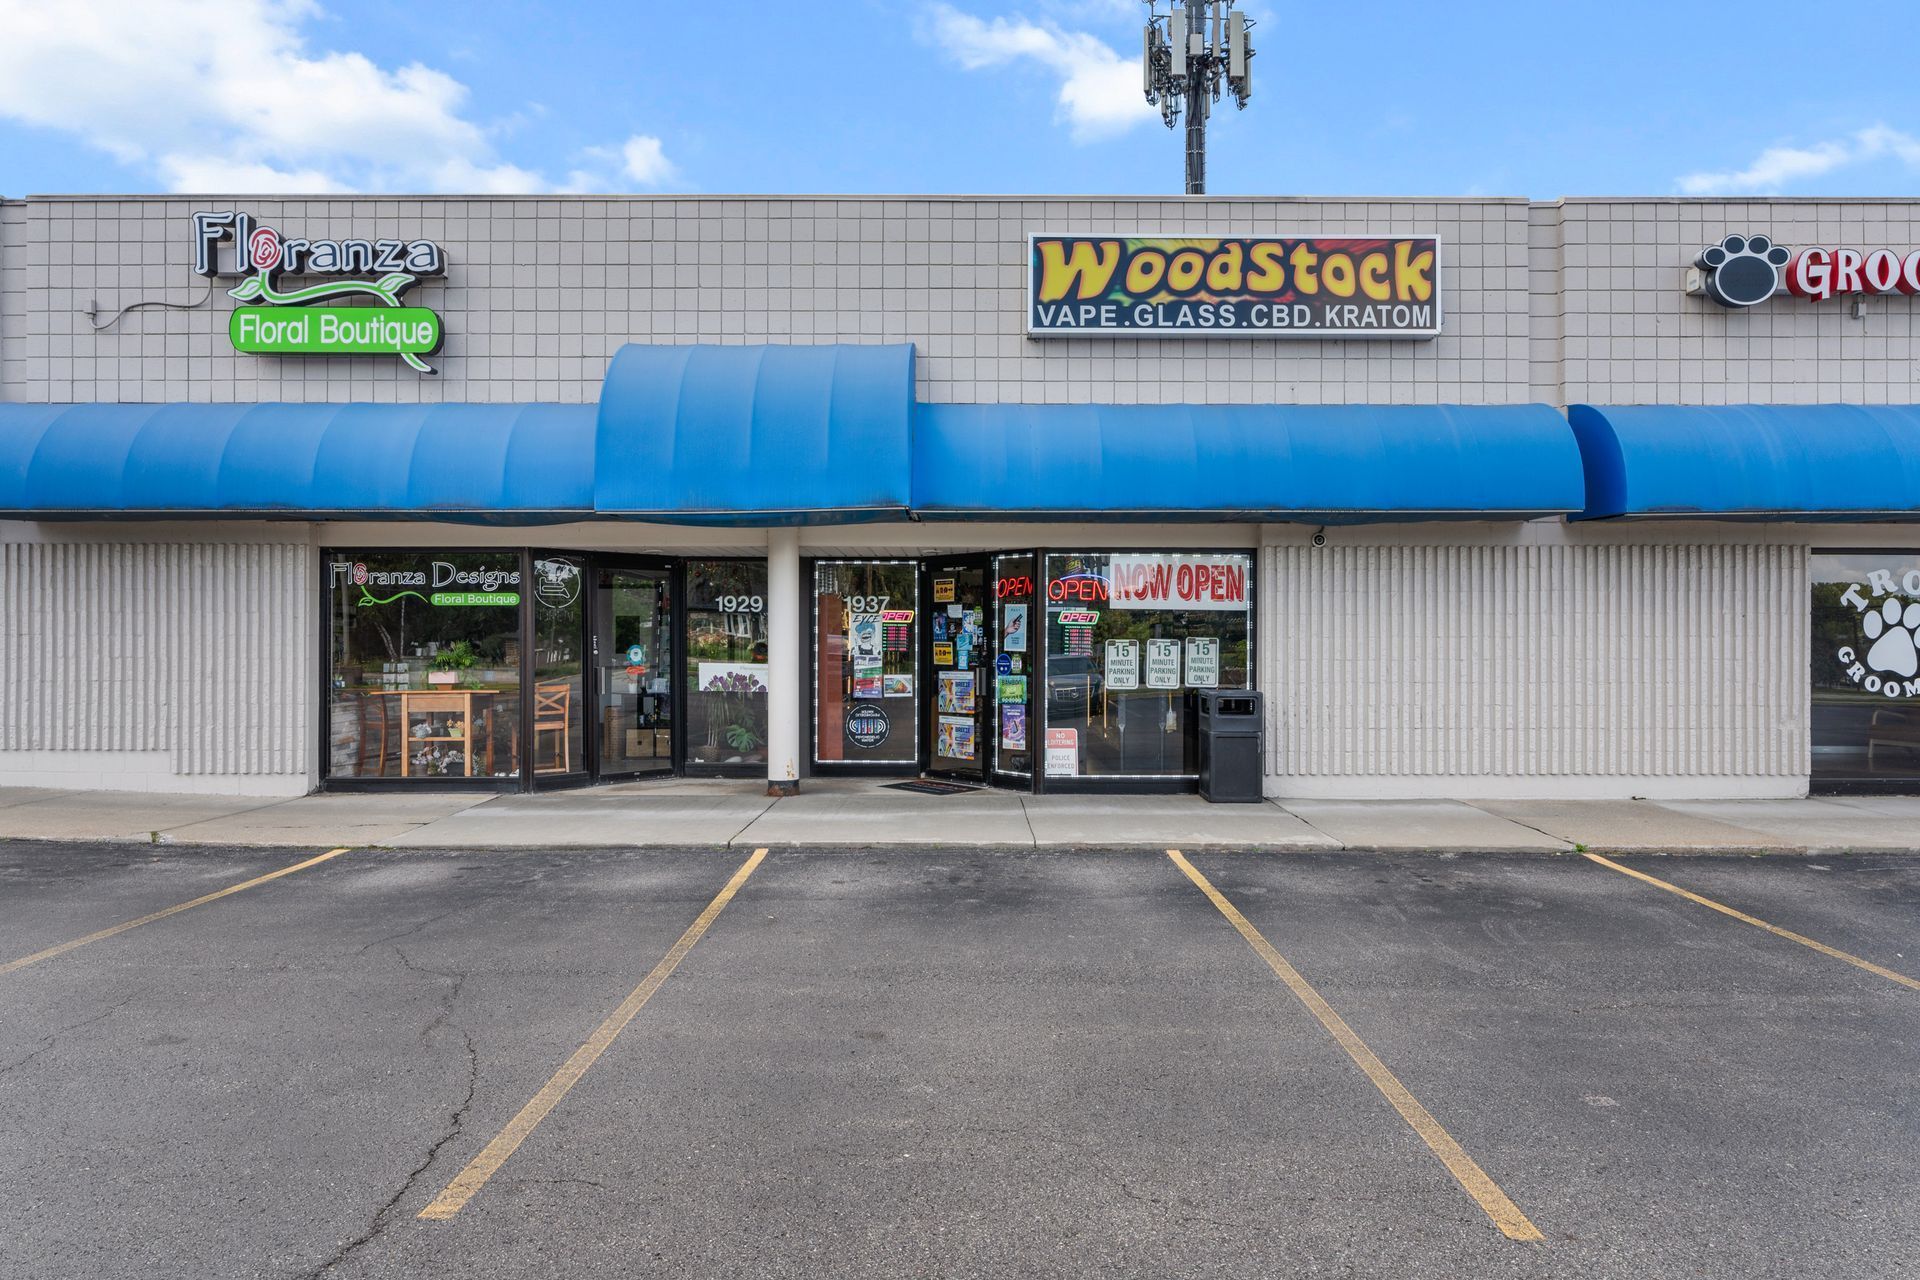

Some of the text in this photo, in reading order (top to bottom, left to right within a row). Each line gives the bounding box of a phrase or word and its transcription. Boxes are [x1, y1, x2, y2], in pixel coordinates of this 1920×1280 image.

[193, 211, 440, 273] Floranza
[239, 314, 433, 350] Floral Boutique
[329, 561, 520, 592] Floranza Designs
[1114, 563, 1245, 602] NOW OPEN
[997, 576, 1033, 598] OPEN
[1048, 579, 1109, 600] OPEN
[434, 594, 517, 606] Floral Boutique
[715, 595, 764, 613] 1929
[843, 595, 890, 613] 1937
[1060, 613, 1097, 622] OPEN
[1114, 645, 1130, 657] 15
[1155, 644, 1171, 657] 15
[1194, 643, 1210, 655] 15
